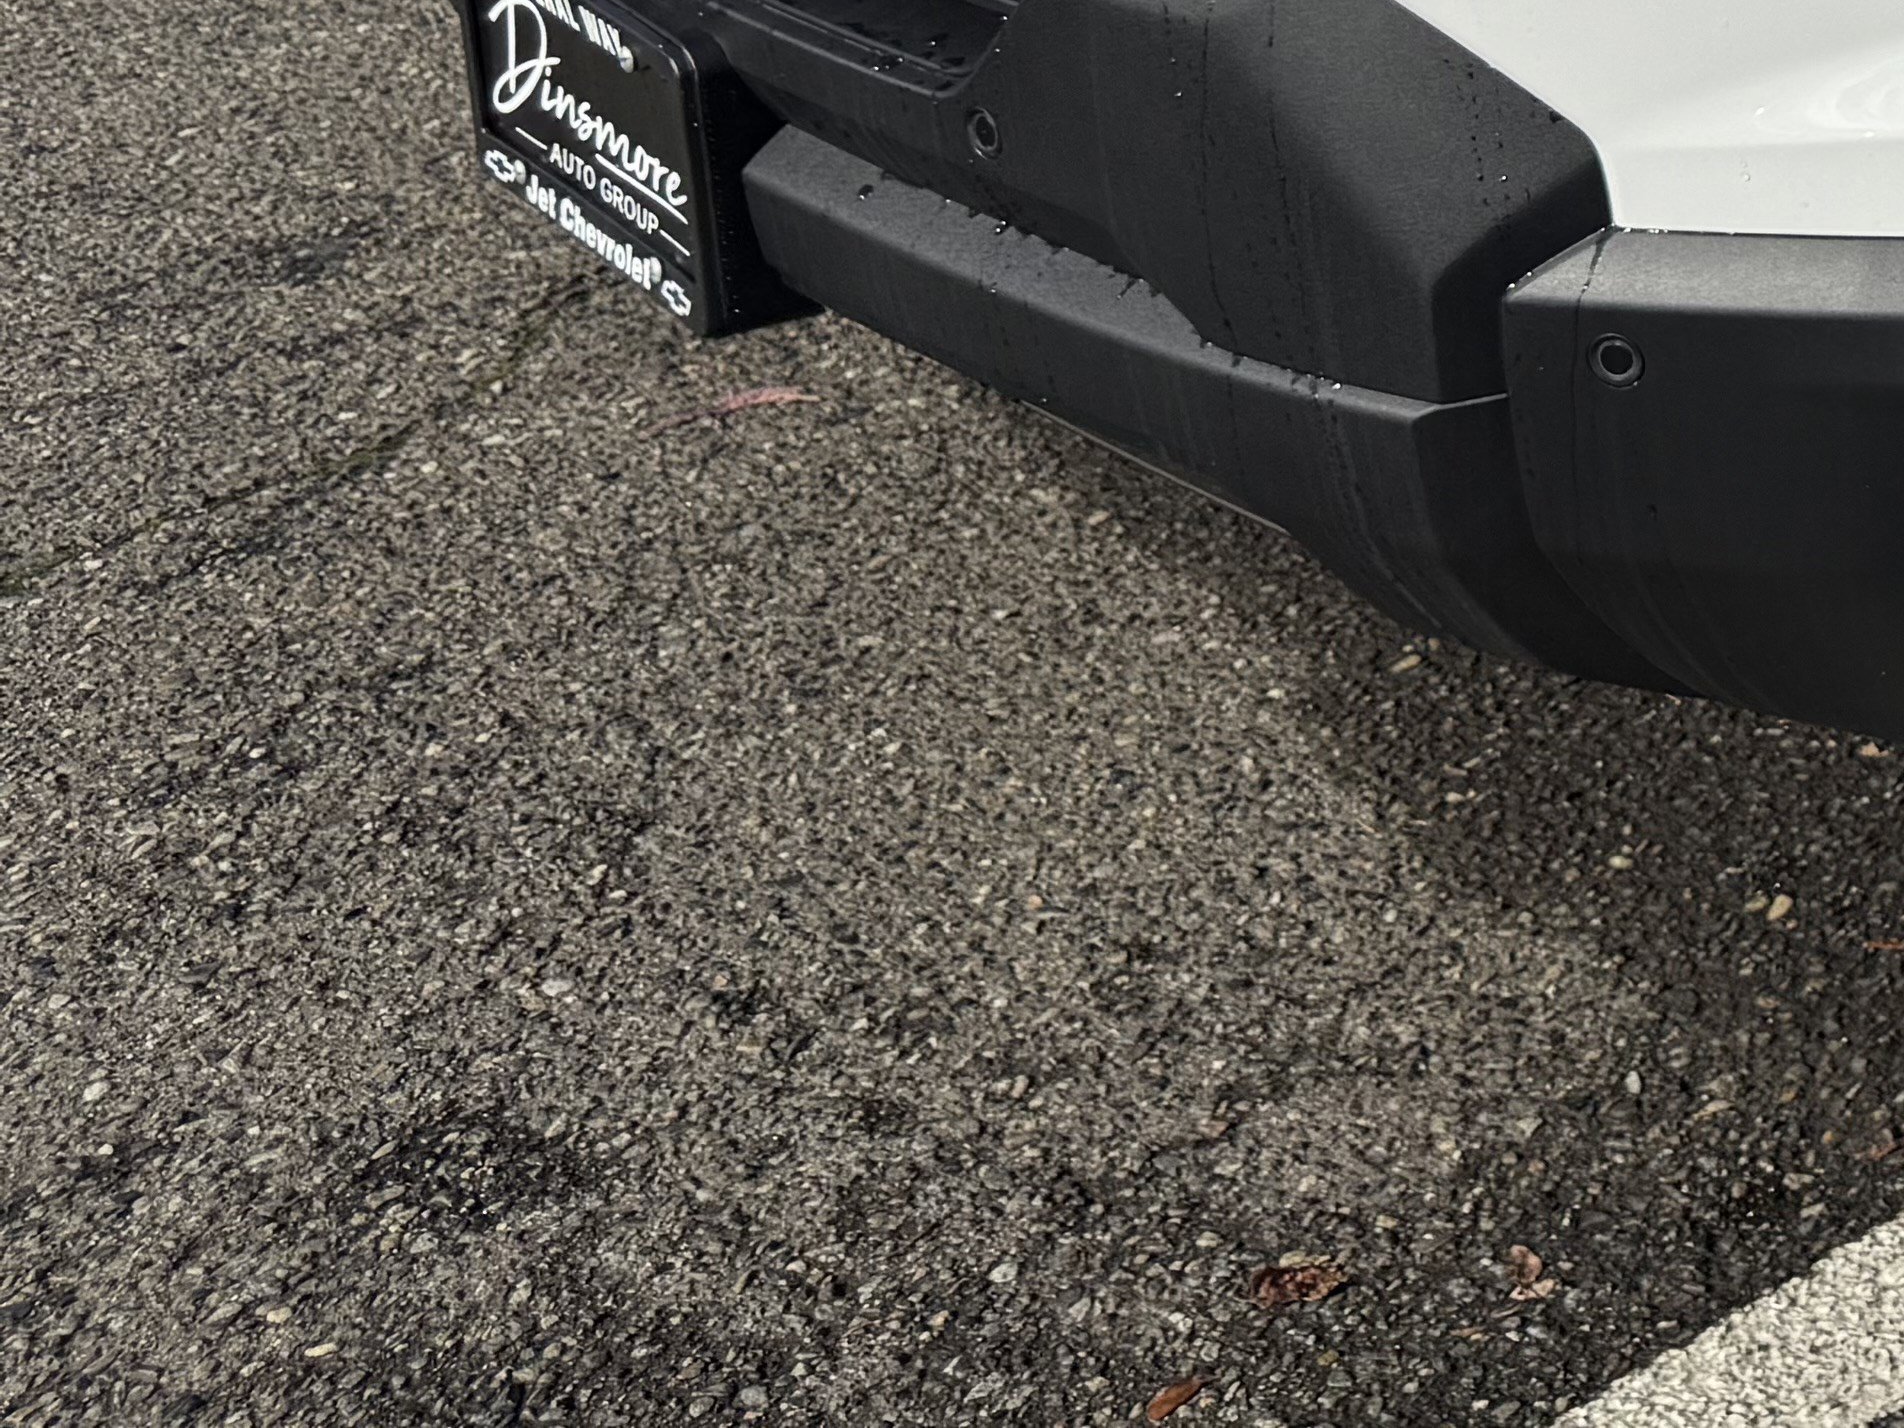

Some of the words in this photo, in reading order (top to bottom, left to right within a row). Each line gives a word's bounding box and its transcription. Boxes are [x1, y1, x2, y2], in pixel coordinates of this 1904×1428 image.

[525, 175, 557, 220] Jet
[559, 197, 652, 290] Chevrolet
[550, 143, 596, 190] AUTO
[600, 177, 660, 234] GROUP
